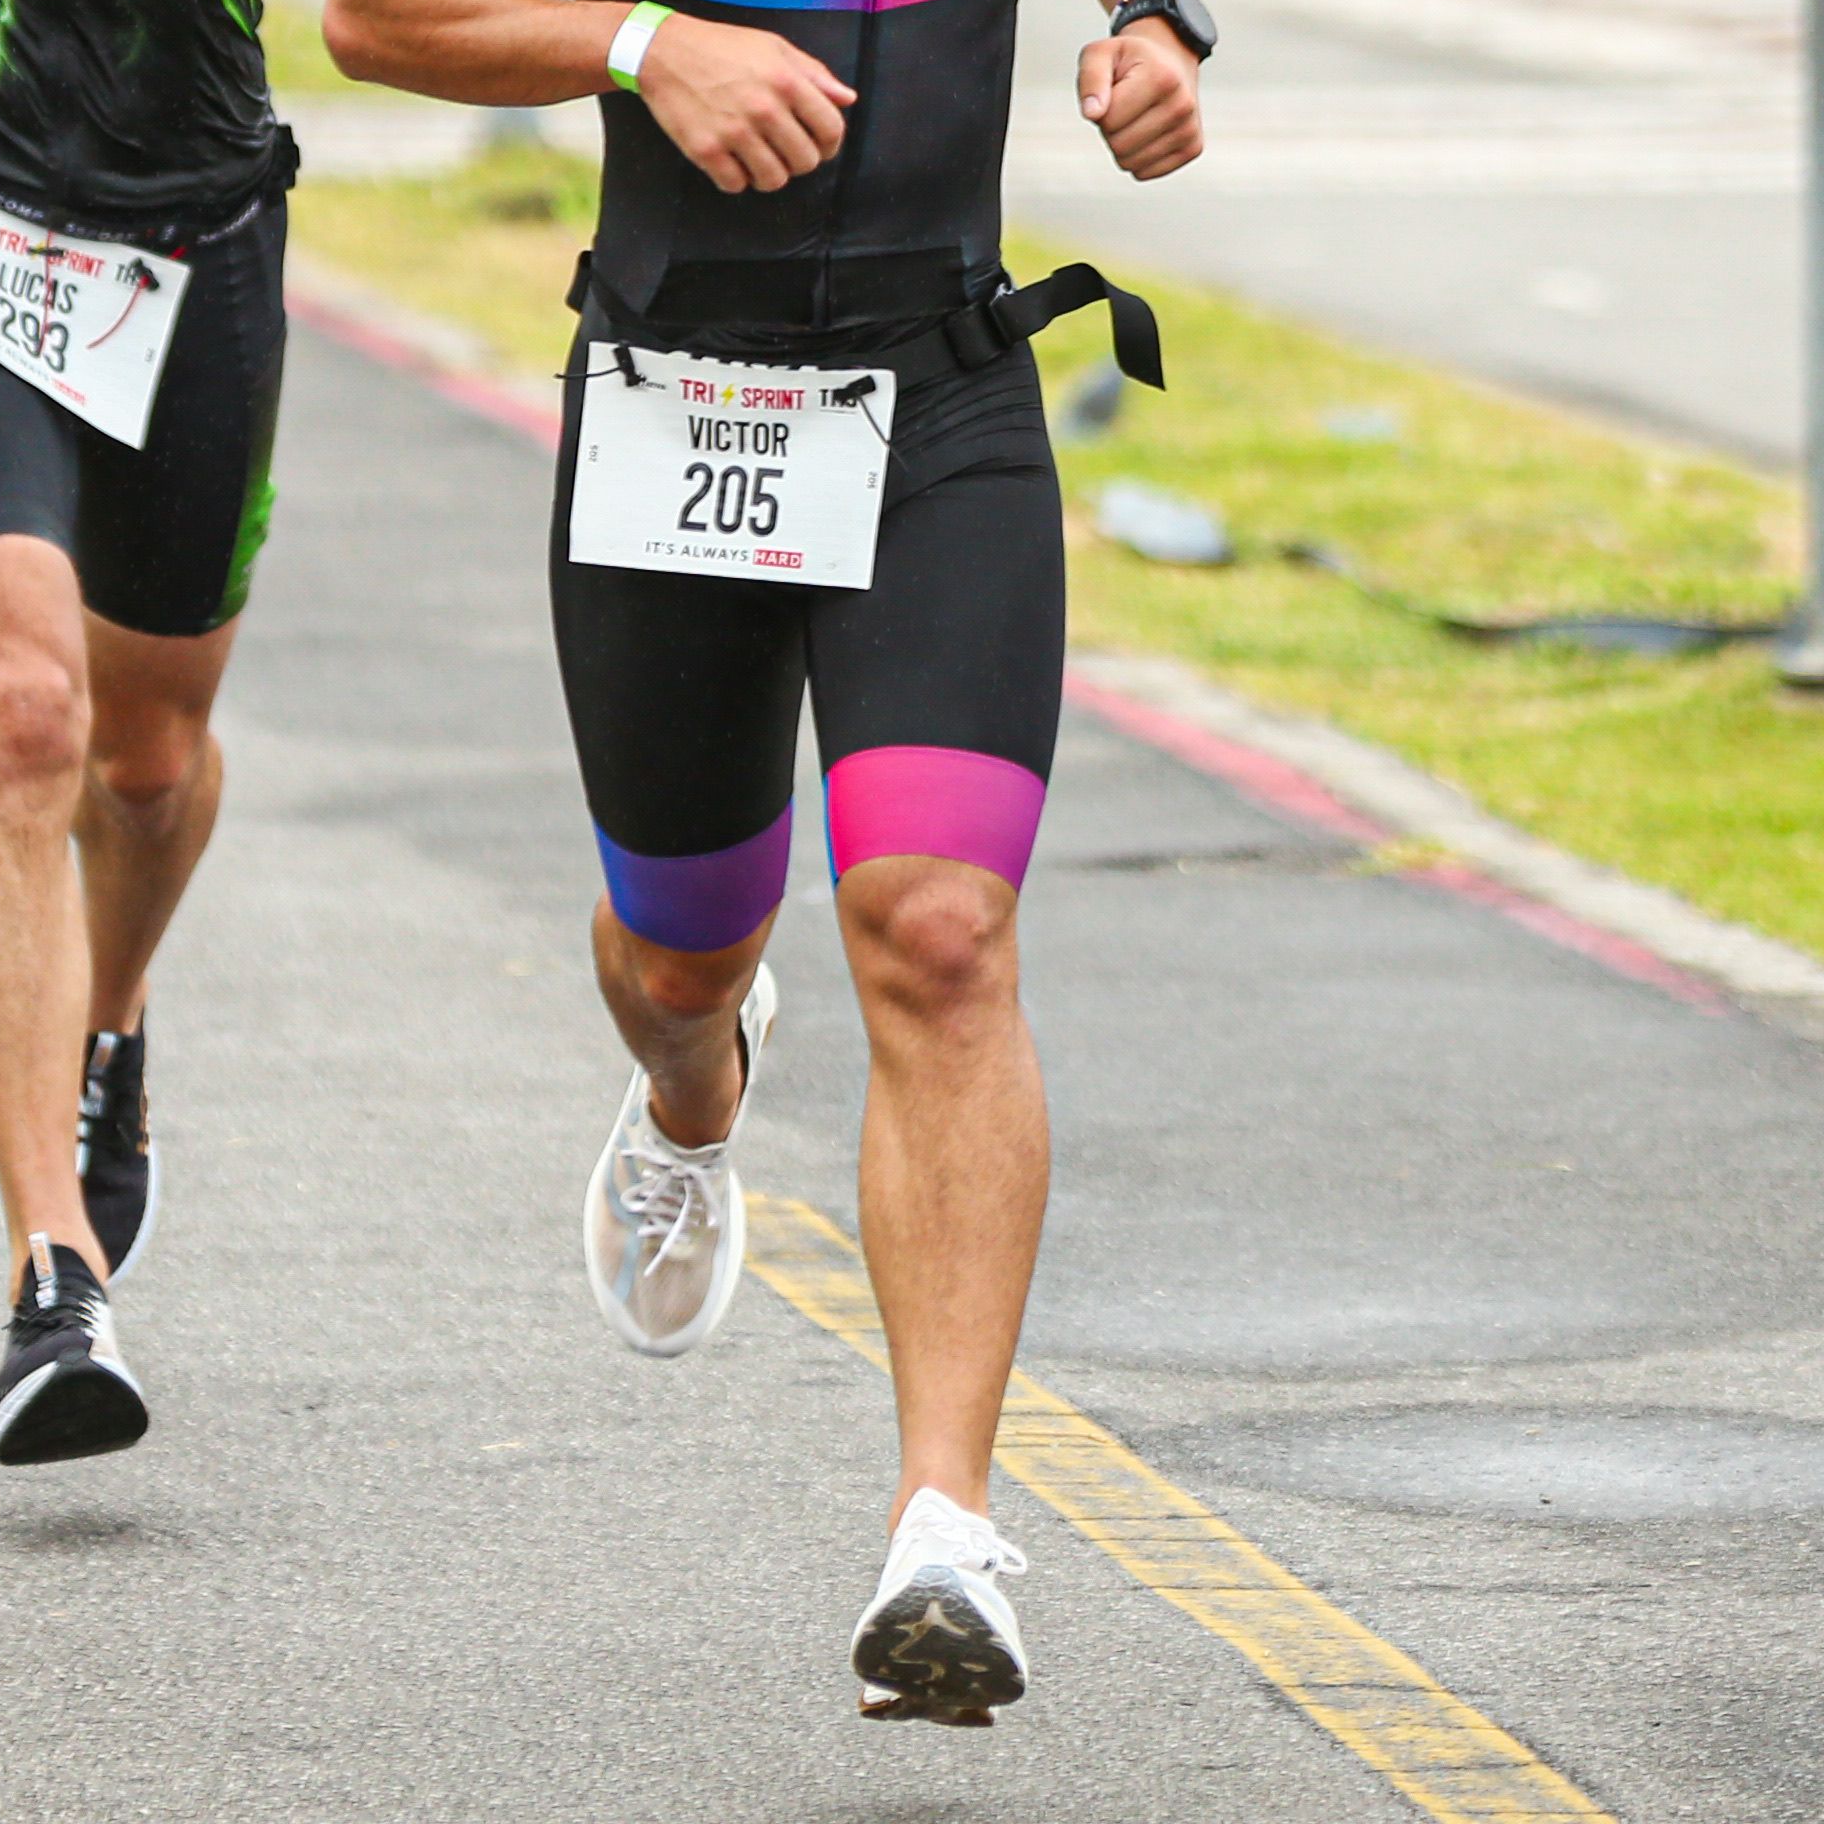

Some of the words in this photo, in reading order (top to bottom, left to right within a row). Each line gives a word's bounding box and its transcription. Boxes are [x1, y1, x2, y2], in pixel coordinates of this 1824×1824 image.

[679, 379, 714, 404] TRI
[741, 387, 805, 410] SPRINT
[687, 415, 790, 457] VICTOR
[677, 461, 785, 537] 205
[645, 541, 675, 556] IT'S
[680, 545, 749, 562] ALWAYS
[754, 550, 801, 568] HARD
